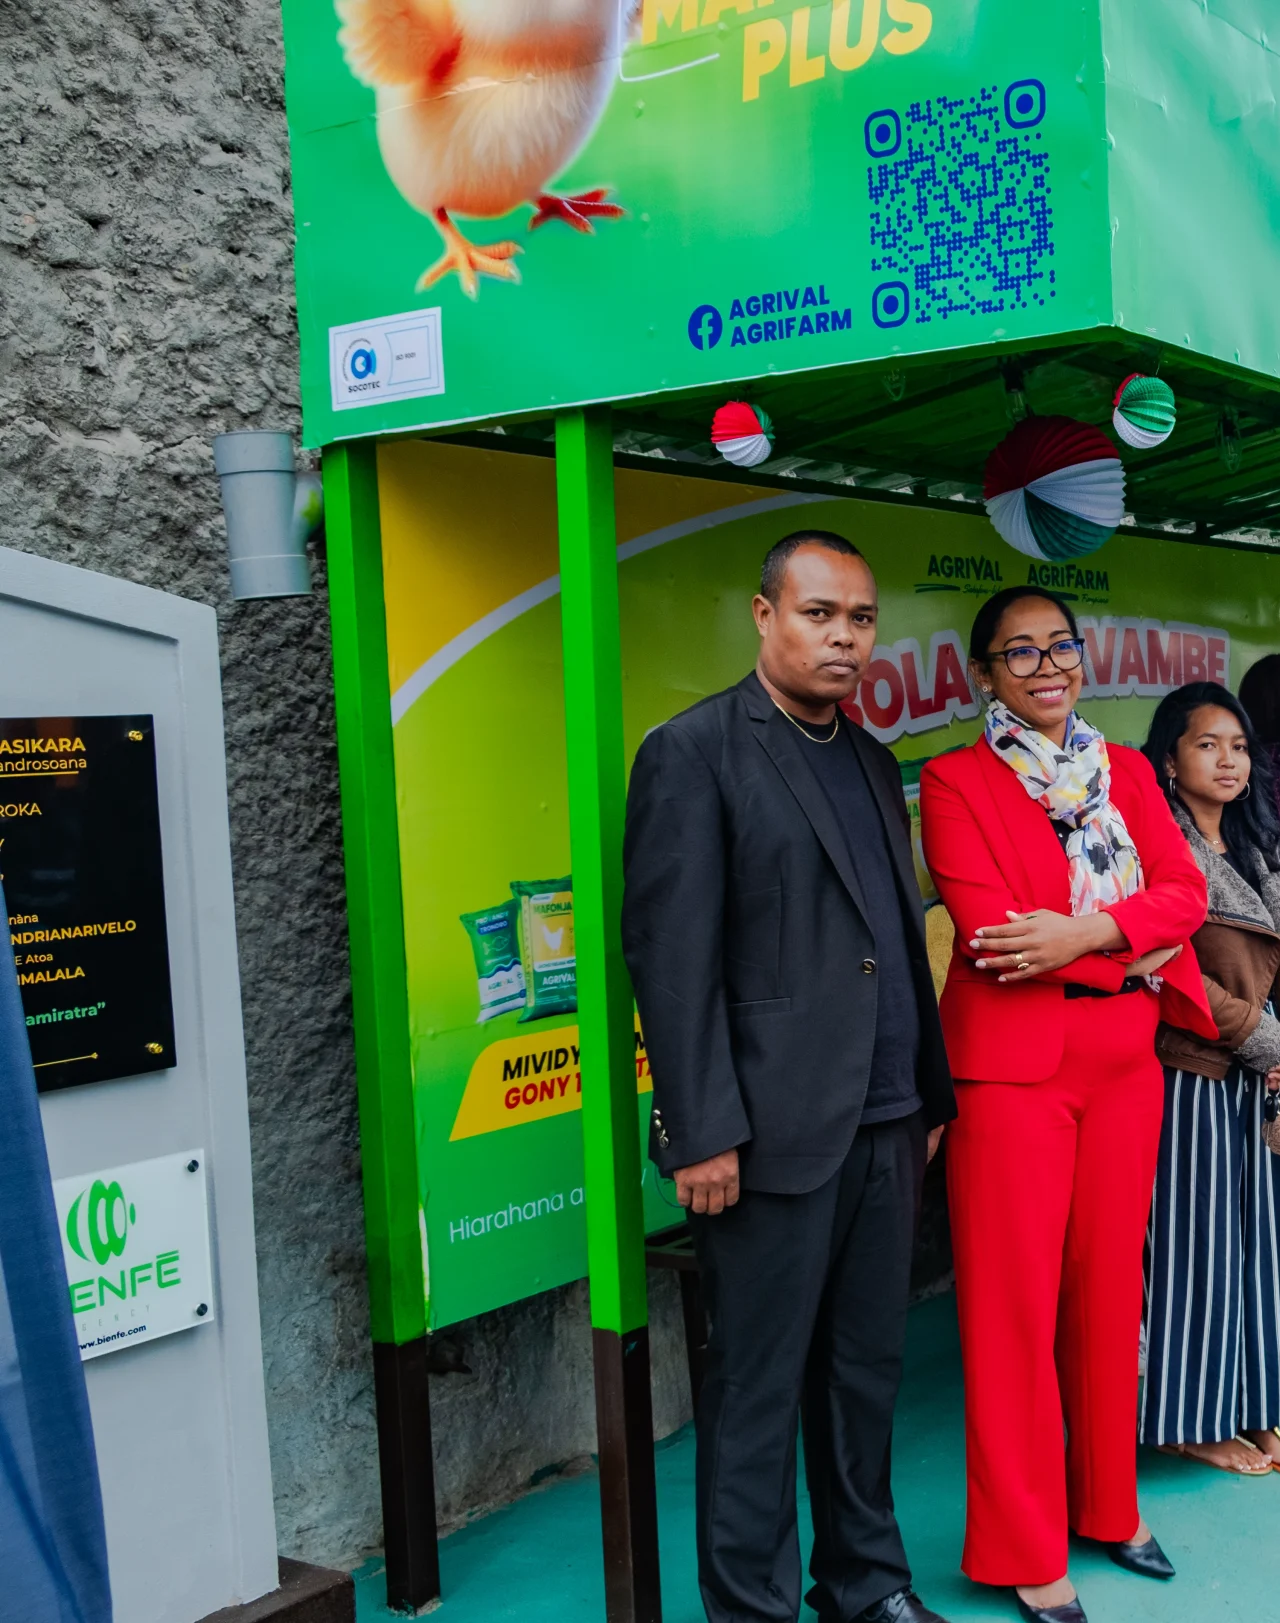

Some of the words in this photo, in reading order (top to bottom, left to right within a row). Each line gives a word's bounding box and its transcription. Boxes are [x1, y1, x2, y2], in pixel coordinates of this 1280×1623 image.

[742, 0, 932, 102] PLUS
[729, 284, 830, 320] AGRIVAL
[730, 308, 852, 347] AGRIFARM
[348, 381, 381, 393] SOCOTEC
[927, 554, 1003, 581] AGRIVAL
[1026, 563, 1110, 591] AGRIFARM
[1081, 627, 1226, 687] VAMBE
[0, 737, 86, 755] ASIKARA
[10, 920, 137, 946] NDRIANARIVELO
[480, 920, 508, 934] TRONDRO
[25, 953, 54, 965] Atoa
[543, 973, 576, 986] AGRIVAL
[502, 1045, 580, 1082] MIVIDY
[504, 1074, 571, 1110] GONY
[449, 1193, 564, 1244] Hiarahana
[79, 1325, 147, 1350] ww.bienfe.com
